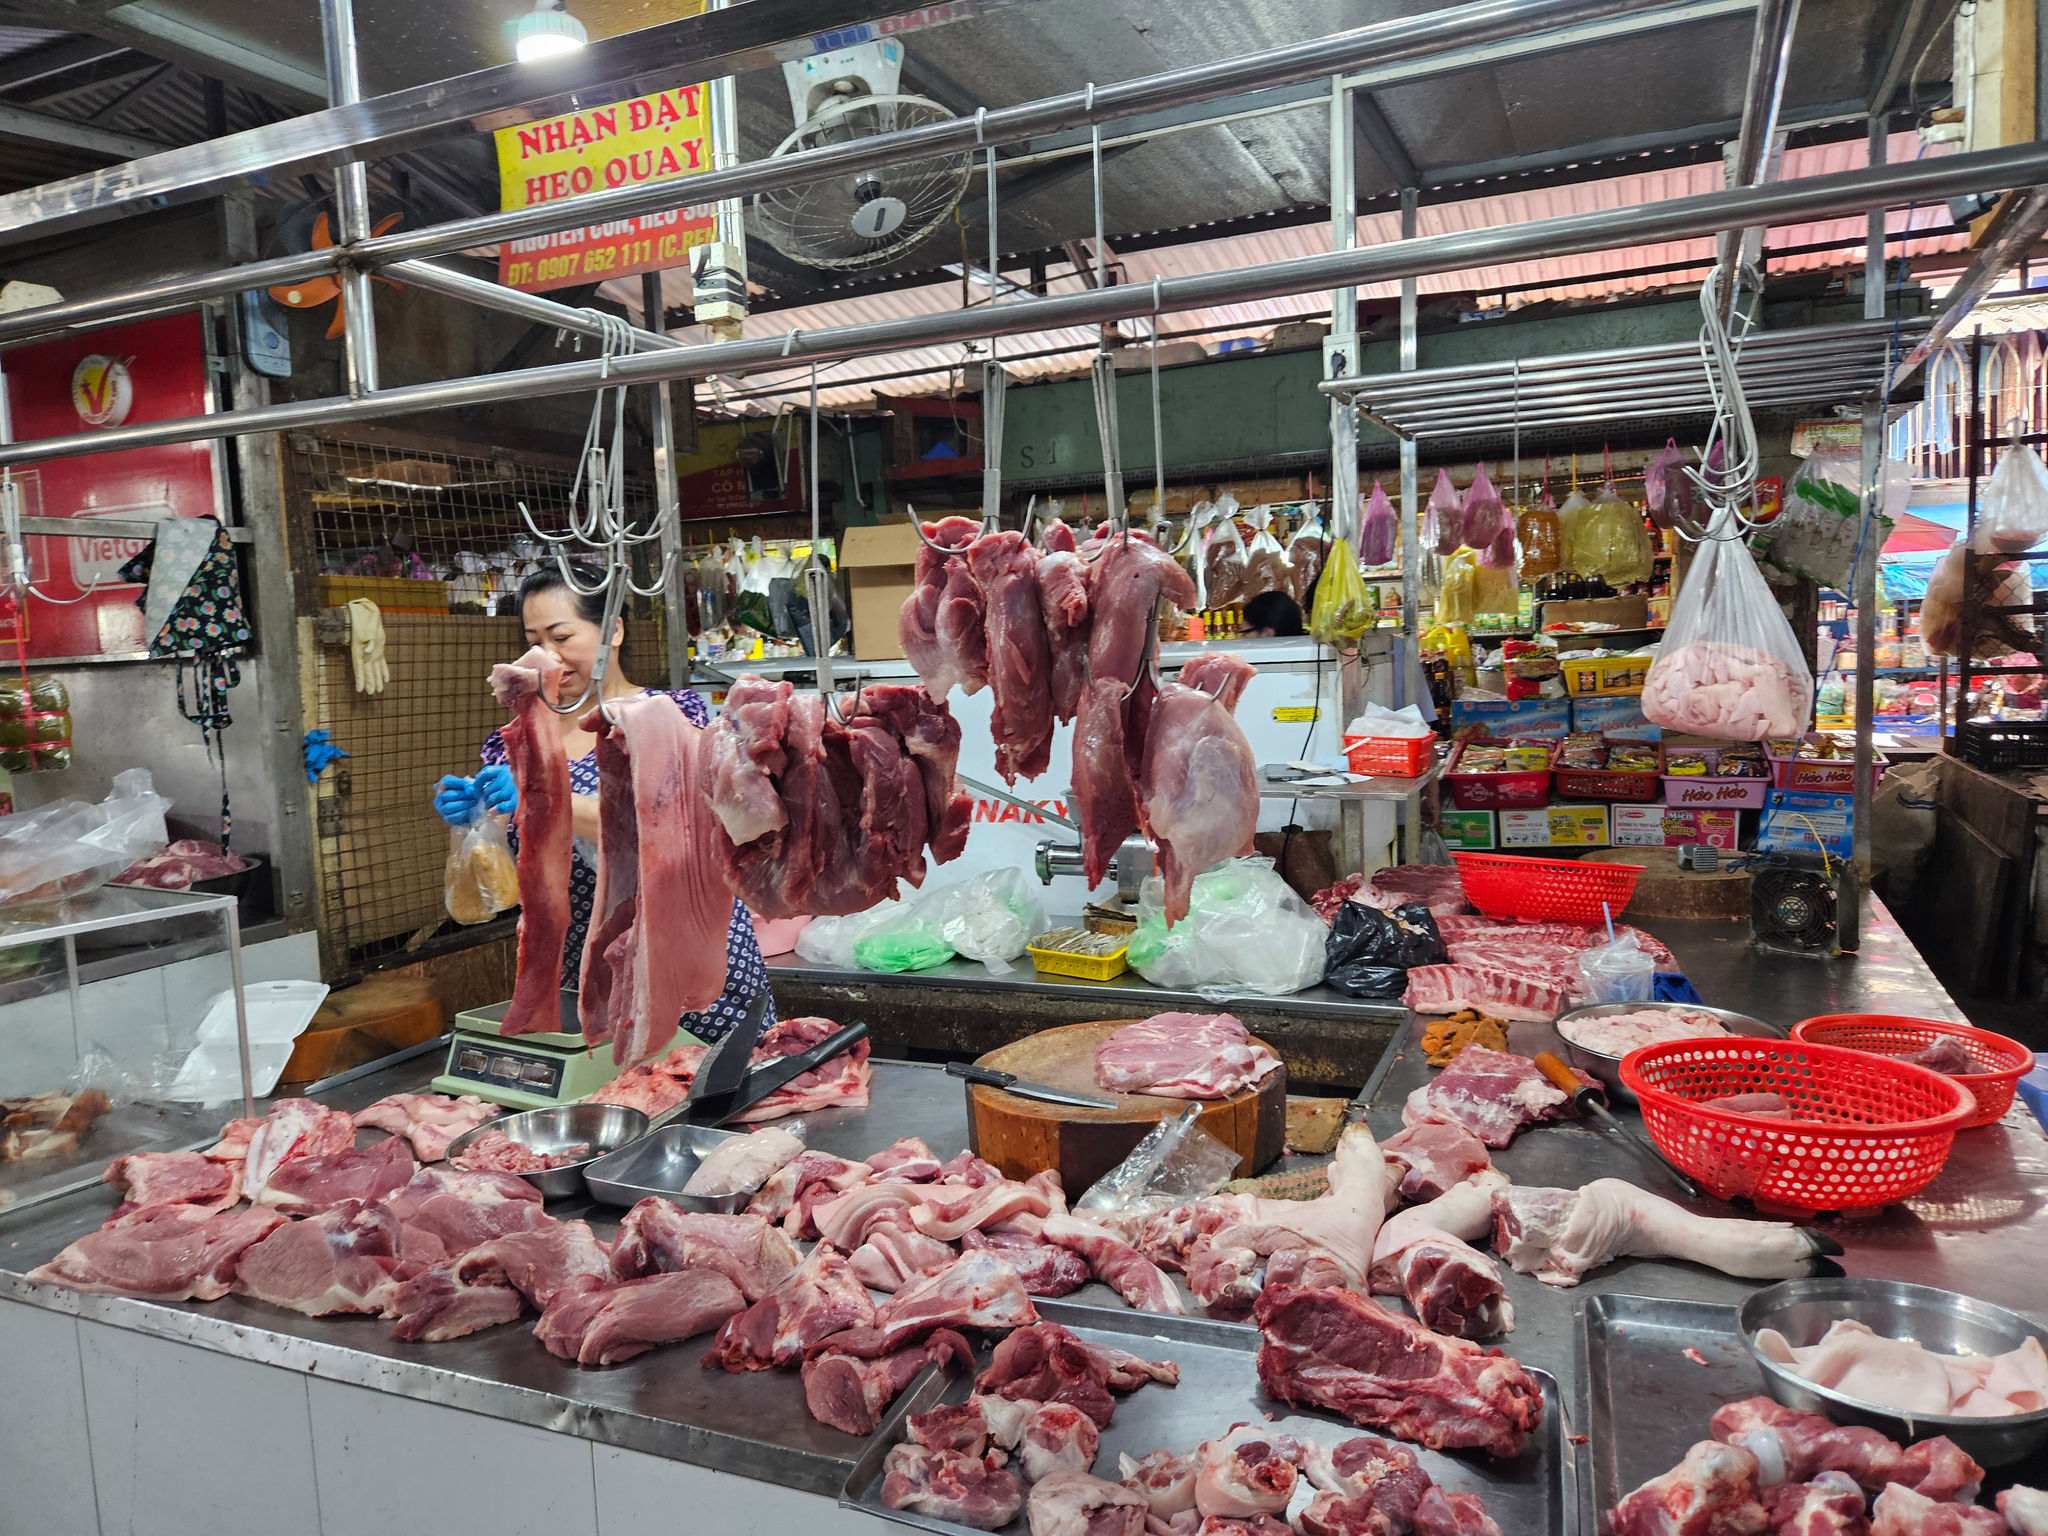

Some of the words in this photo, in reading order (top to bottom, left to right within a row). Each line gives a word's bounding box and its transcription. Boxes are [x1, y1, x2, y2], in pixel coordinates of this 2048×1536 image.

[525, 166, 593, 205] HEO
[605, 138, 702, 188] QUAY
[537, 252, 581, 282] 0907
[583, 246, 617, 274] 652
[621, 239, 652, 266] 111
[79, 537, 148, 563] VietG
[1681, 785, 1714, 803] Hảo
[1716, 783, 1749, 801] Hảo
